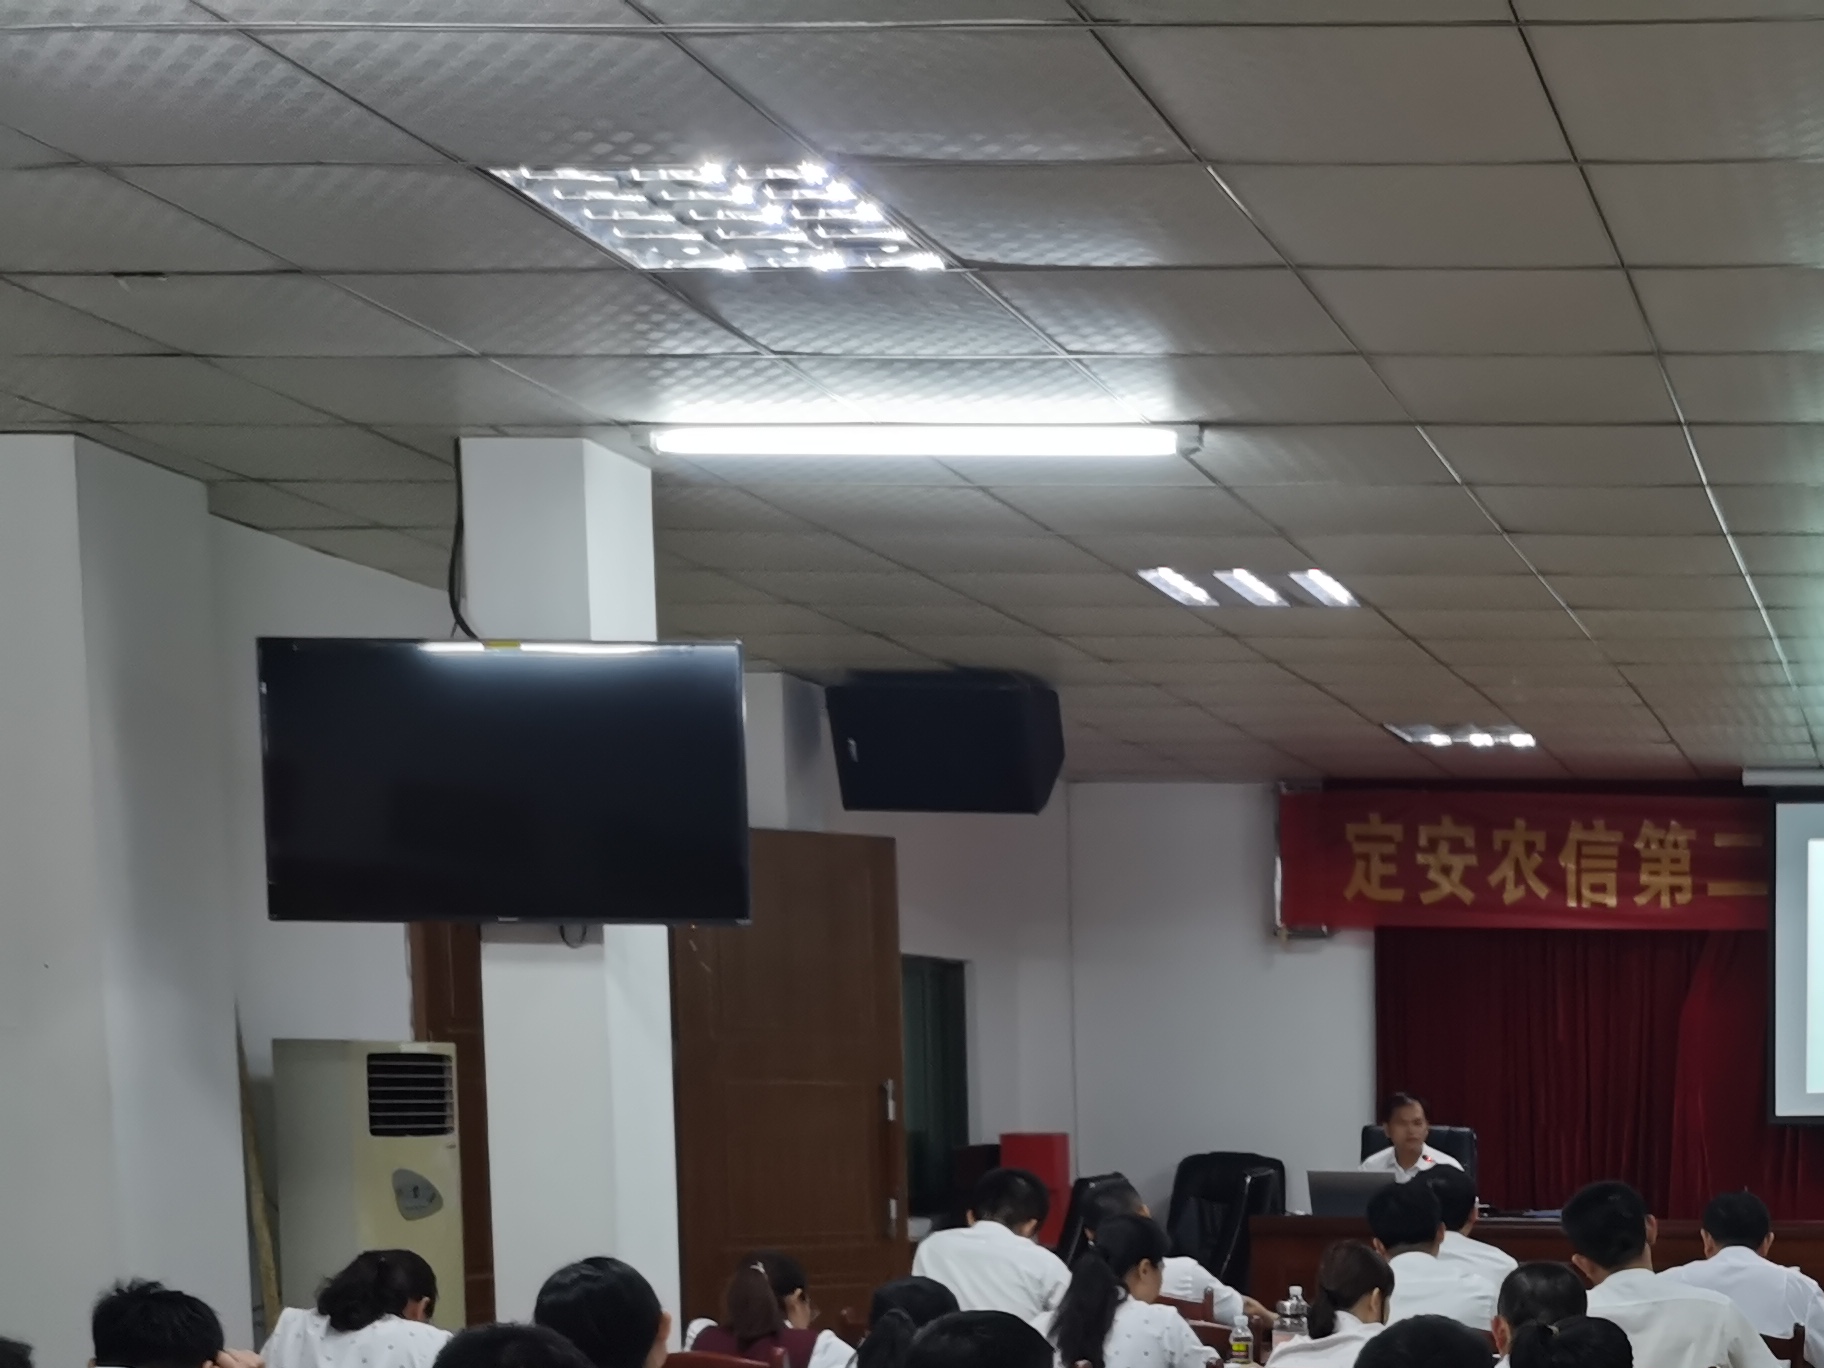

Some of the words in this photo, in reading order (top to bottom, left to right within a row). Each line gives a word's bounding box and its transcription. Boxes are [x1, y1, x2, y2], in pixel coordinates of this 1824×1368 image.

[1343, 813, 1769, 908] 定安农信第二
